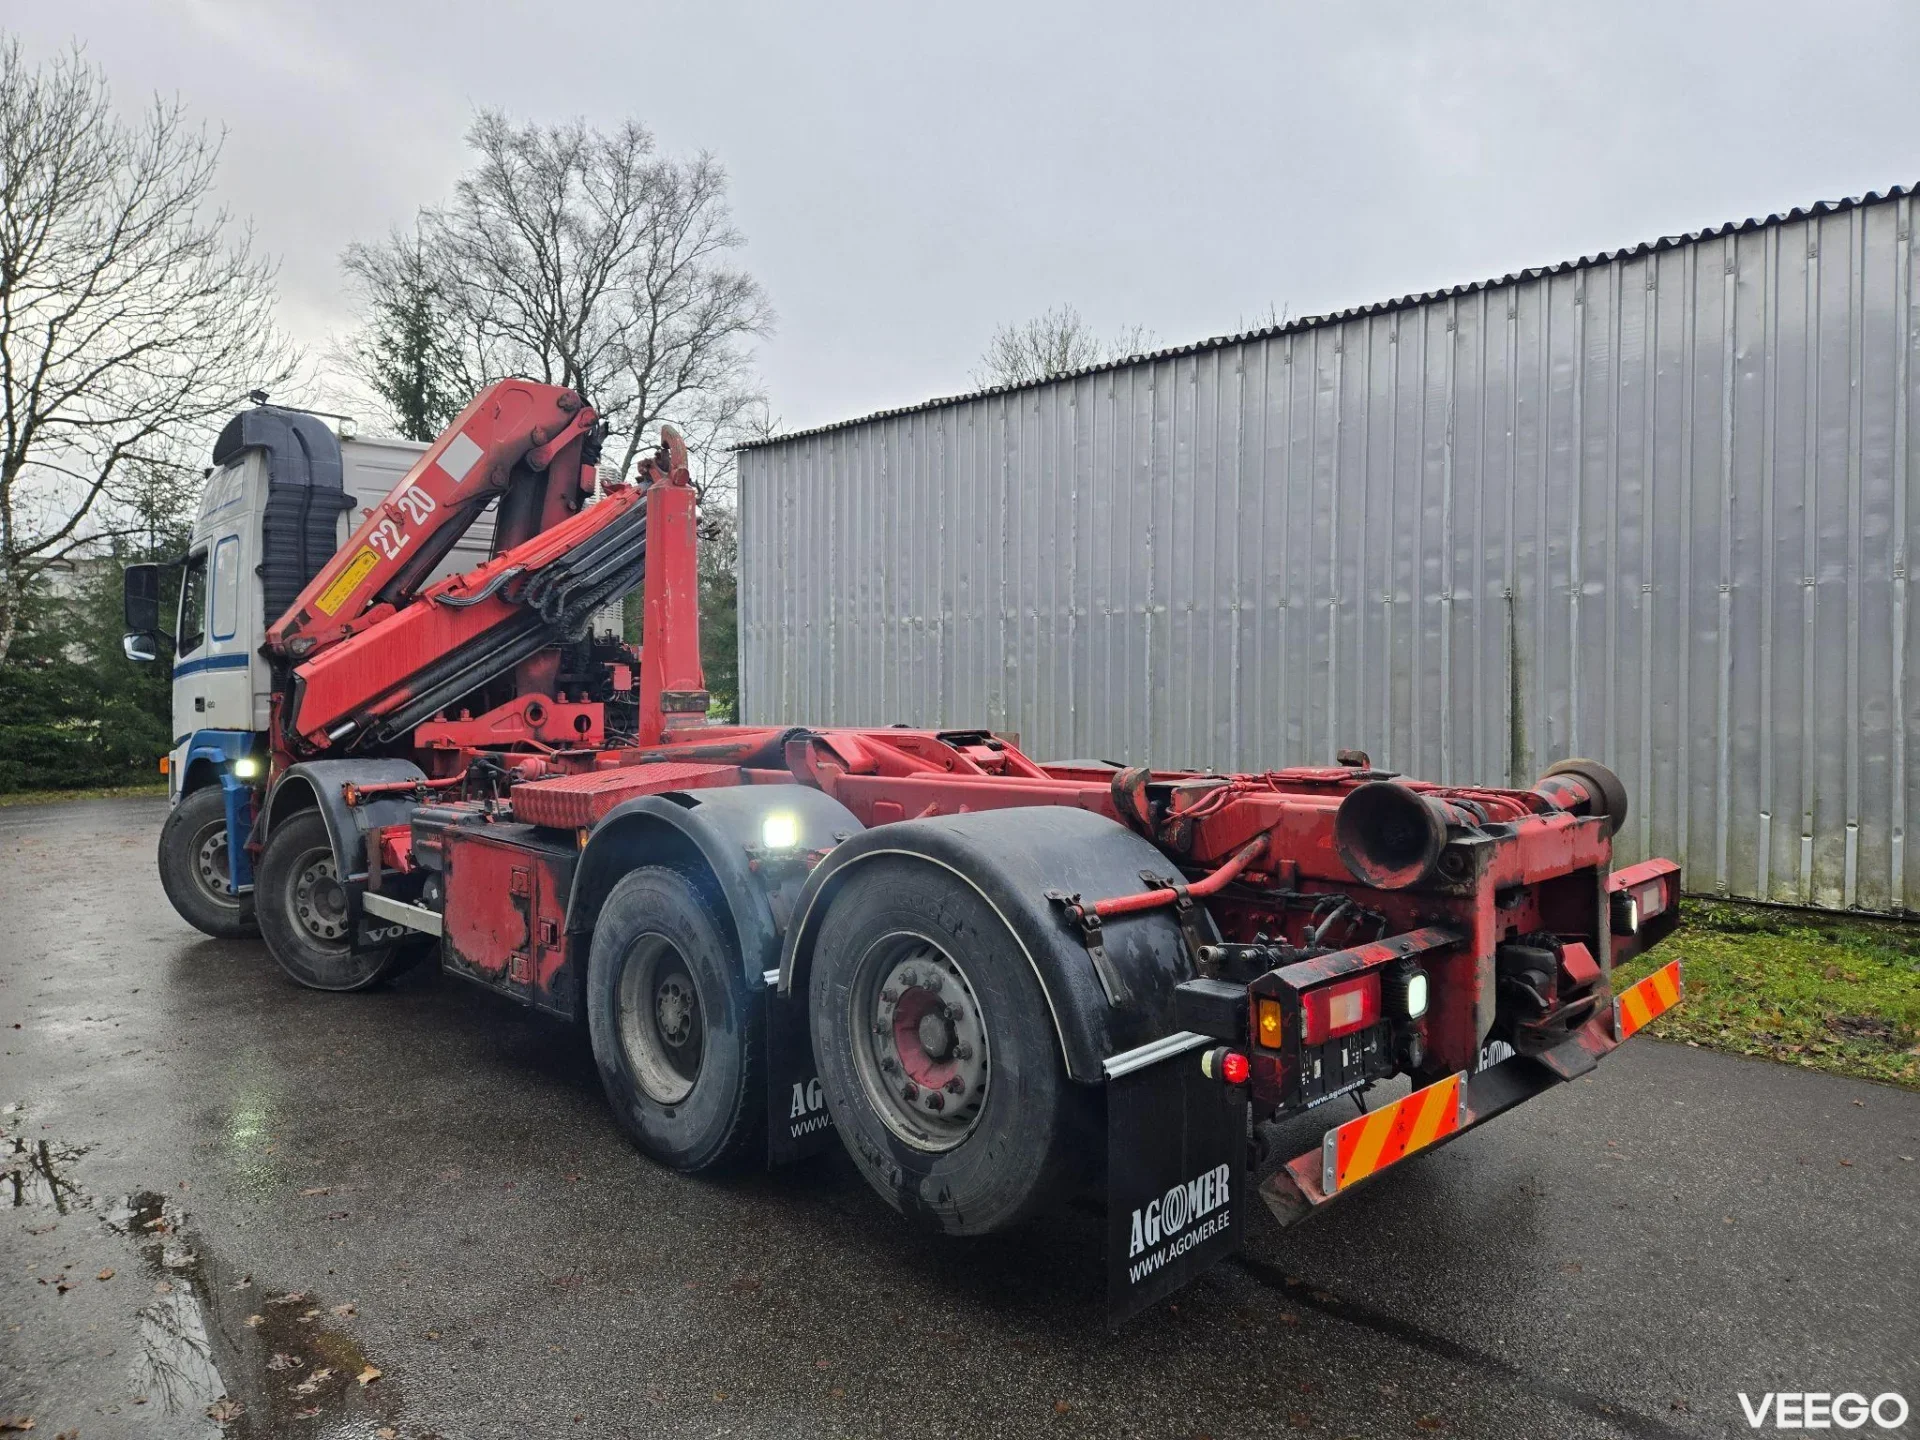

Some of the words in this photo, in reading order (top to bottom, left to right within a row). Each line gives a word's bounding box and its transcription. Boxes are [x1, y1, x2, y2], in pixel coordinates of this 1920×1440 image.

[369, 519, 410, 560] 22
[398, 485, 436, 525] 20
[790, 1077, 823, 1118] AG
[1129, 1210, 1230, 1284] WWW.AGOMER.EE
